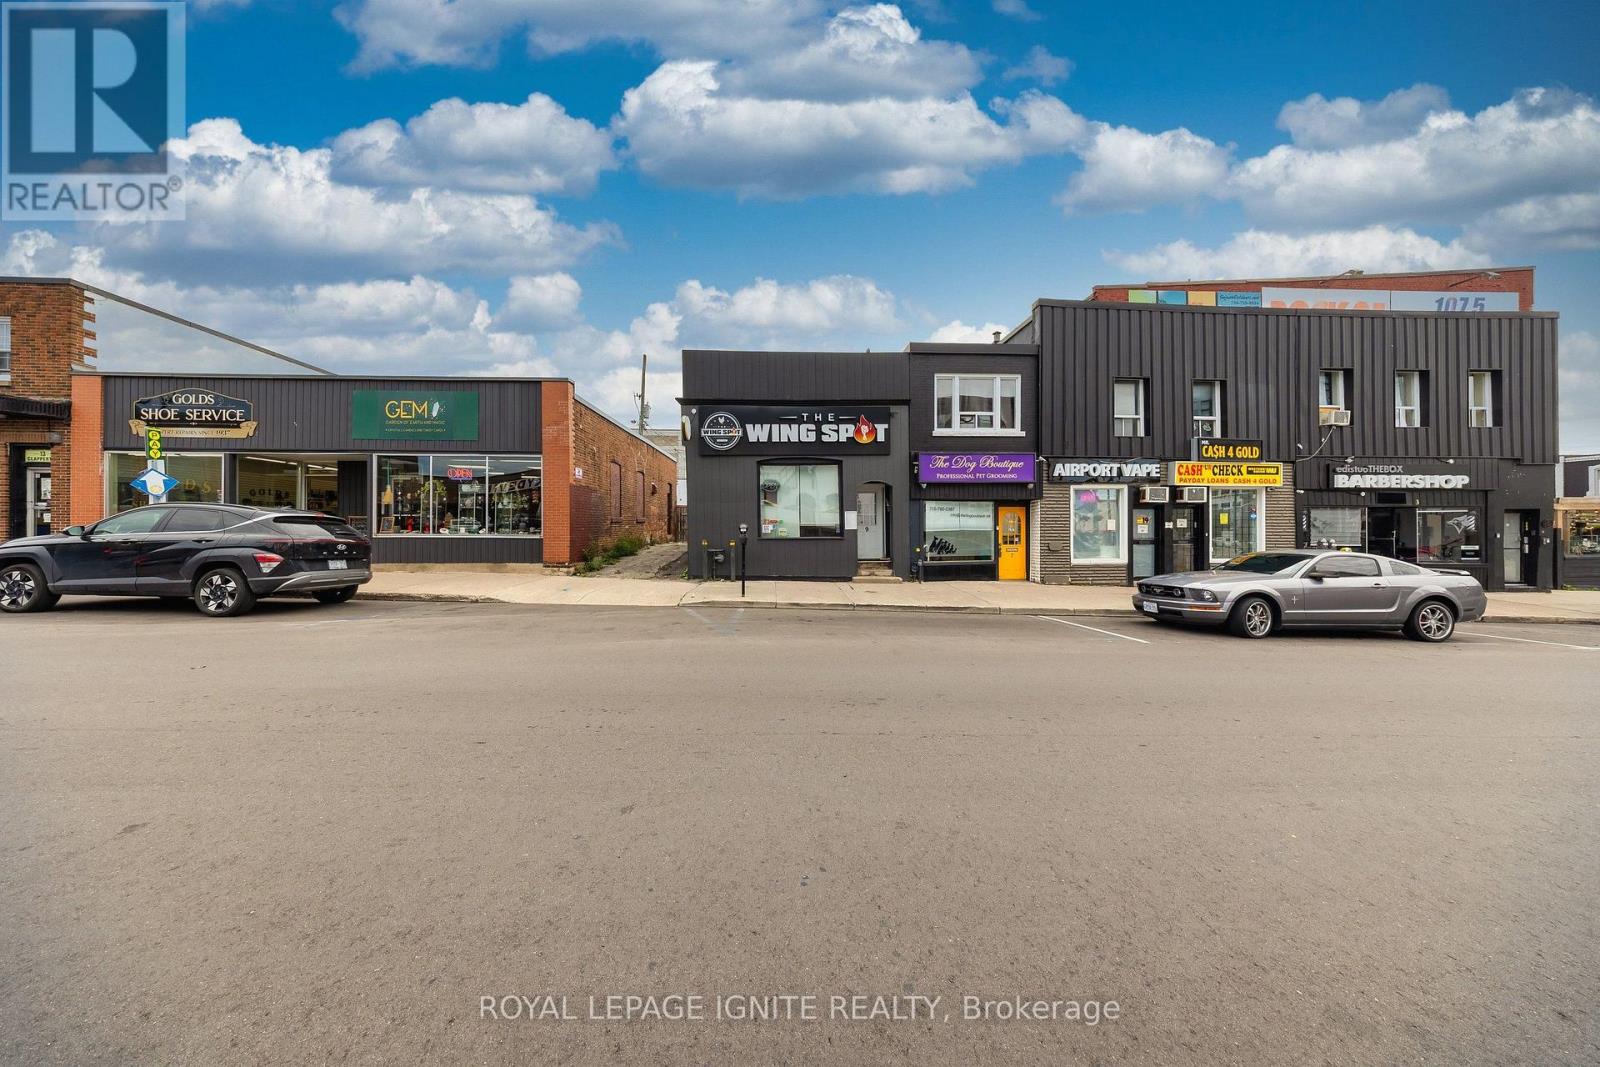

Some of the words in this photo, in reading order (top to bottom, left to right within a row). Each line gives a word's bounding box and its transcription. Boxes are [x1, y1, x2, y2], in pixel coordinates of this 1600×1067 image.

[172, 393, 215, 405] GOLDS
[140, 408, 180, 421] SHOE
[185, 408, 246, 421] SERVICE
[385, 400, 428, 419] GEM
[801, 413, 835, 422] THE
[745, 423, 816, 443] WING
[821, 419, 889, 444] SPOT
[150, 431, 159, 458] PAY
[1202, 444, 1226, 459] CA$H
[1227, 446, 1233, 458] 4
[1235, 446, 1260, 459] GOLD
[930, 455, 949, 468] The
[951, 455, 977, 473] Dog
[980, 455, 1024, 471] Boutique
[1053, 463, 1120, 477] AIRPORT
[1120, 463, 1160, 477] VAPE
[1177, 464, 1203, 476] CASH
[1212, 464, 1244, 476] CHECK
[448, 468, 473, 478] OPEN
[1334, 474, 1470, 489] BARBERSHOP
